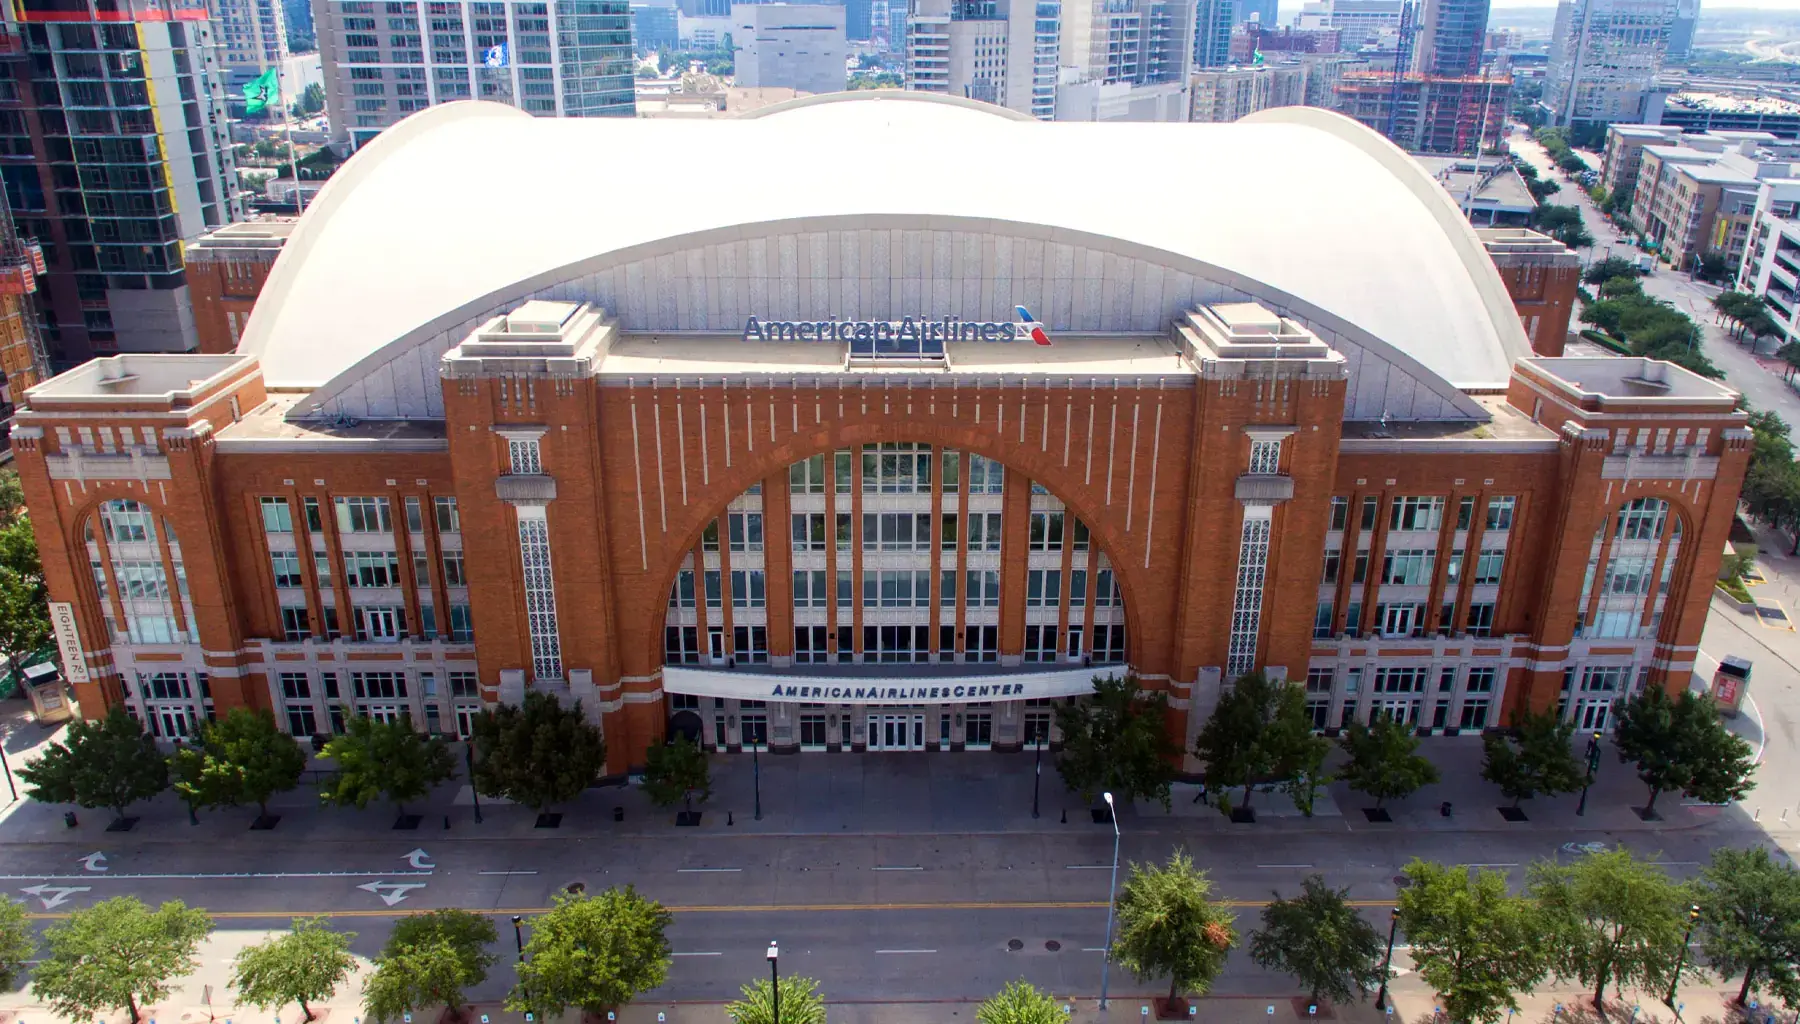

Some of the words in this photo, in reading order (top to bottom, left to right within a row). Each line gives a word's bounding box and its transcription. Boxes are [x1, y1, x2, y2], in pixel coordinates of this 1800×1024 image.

[741, 314, 891, 343] American
[896, 314, 1015, 343] Airlines
[57, 605, 80, 661] EIGHTEEN
[72, 665, 84, 673] 76
